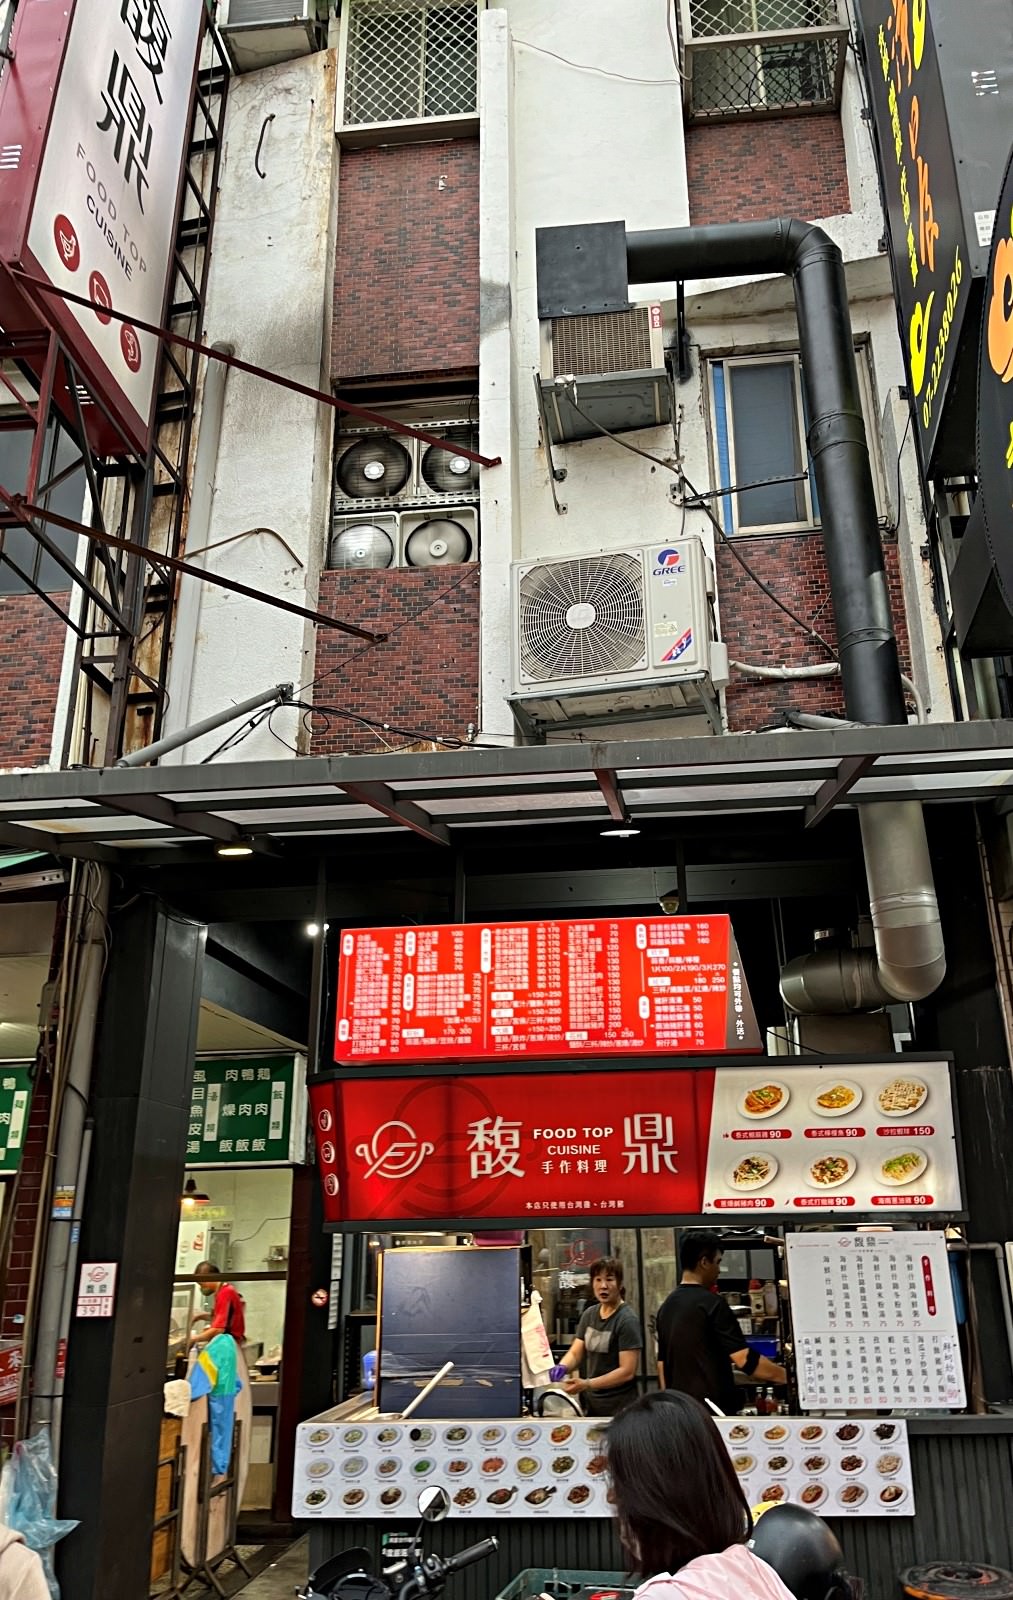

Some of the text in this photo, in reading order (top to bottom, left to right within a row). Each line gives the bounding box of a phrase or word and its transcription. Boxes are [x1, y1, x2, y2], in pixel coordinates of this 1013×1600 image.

[76, 142, 147, 274] FOOD TOP
[86, 195, 133, 282] CUISINE
[652, 565, 686, 576] GREE
[186, 1070, 206, 1154] 虱目魚皮湯
[533, 1127, 614, 1139] FOOD TOP
[770, 1130, 782, 1138] 90
[466, 1113, 679, 1180] 馥 鼎
[547, 1144, 601, 1156] CUISINE
[541, 1160, 608, 1174] 手作料理
[754, 1199, 766, 1207] 90
[836, 1198, 848, 1206] 90
[914, 1196, 926, 1204] 90
